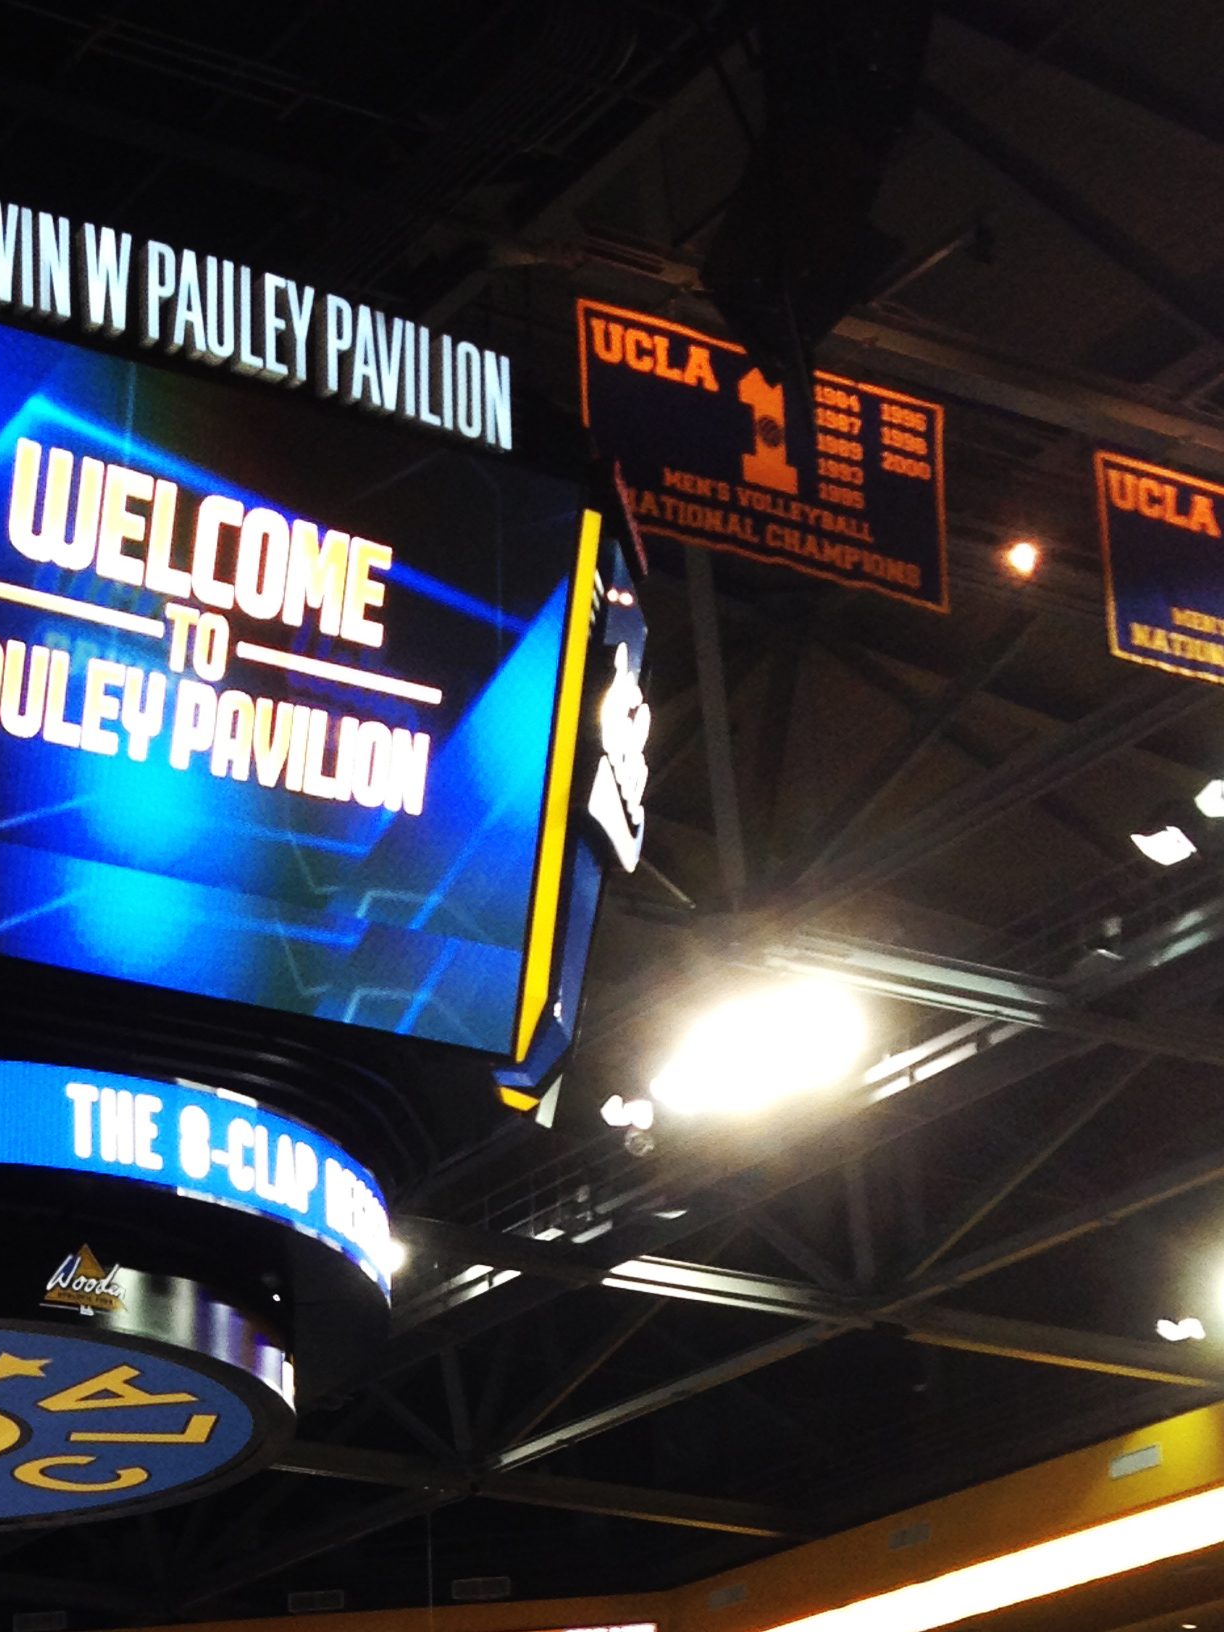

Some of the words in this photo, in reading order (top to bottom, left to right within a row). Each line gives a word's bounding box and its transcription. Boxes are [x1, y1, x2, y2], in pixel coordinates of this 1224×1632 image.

[83, 222, 131, 336] W
[146, 240, 314, 385] PAULEY
[325, 293, 513, 452] PAVILION
[590, 318, 718, 393] UCLA
[736, 486, 874, 543] VOLLEYBALL
[1106, 468, 1222, 539] UCLA
[7, 436, 393, 649] WELCOME
[765, 522, 921, 590] CHAMPIONS
[164, 602, 229, 681] TO
[169, 680, 431, 816] PAVILION
[66, 1082, 163, 1170] THE
[179, 1105, 318, 1213] 8-CLAP
[46, 1254, 126, 1300] Wooden
